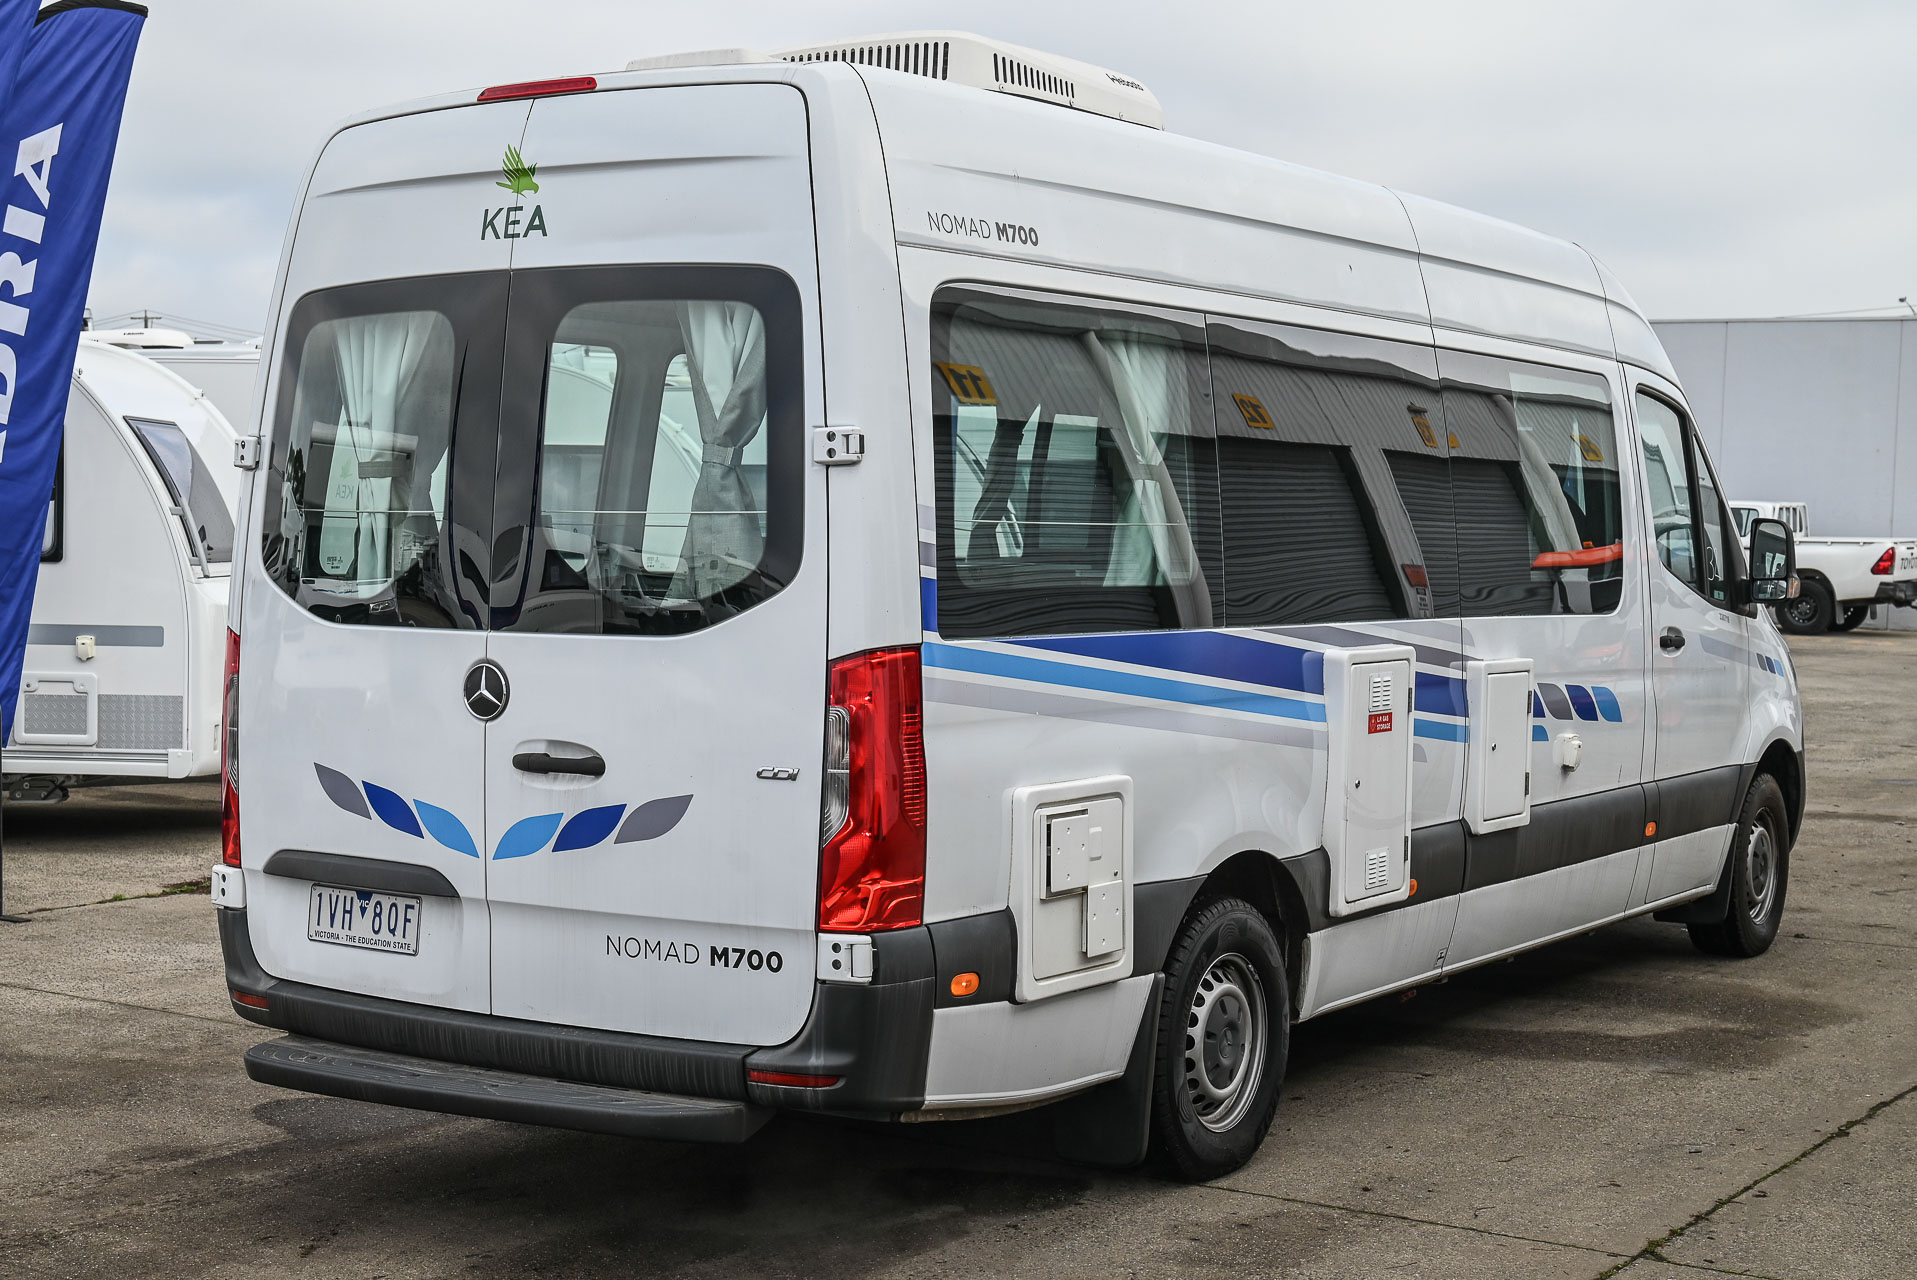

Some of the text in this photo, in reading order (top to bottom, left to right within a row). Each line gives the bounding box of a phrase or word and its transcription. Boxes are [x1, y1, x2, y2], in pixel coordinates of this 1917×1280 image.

[480, 204, 548, 241] KEA
[927, 211, 1039, 247] NOMAD M700
[0, 122, 63, 463] RIA
[756, 766, 800, 781] CDI
[316, 892, 415, 939] 1VH 8QF
[314, 929, 340, 941] VICTORIA
[345, 934, 357, 944] THE
[358, 936, 392, 948] EDUCATION
[392, 942, 411, 951] STATE
[606, 934, 783, 974] NOMAD M700
